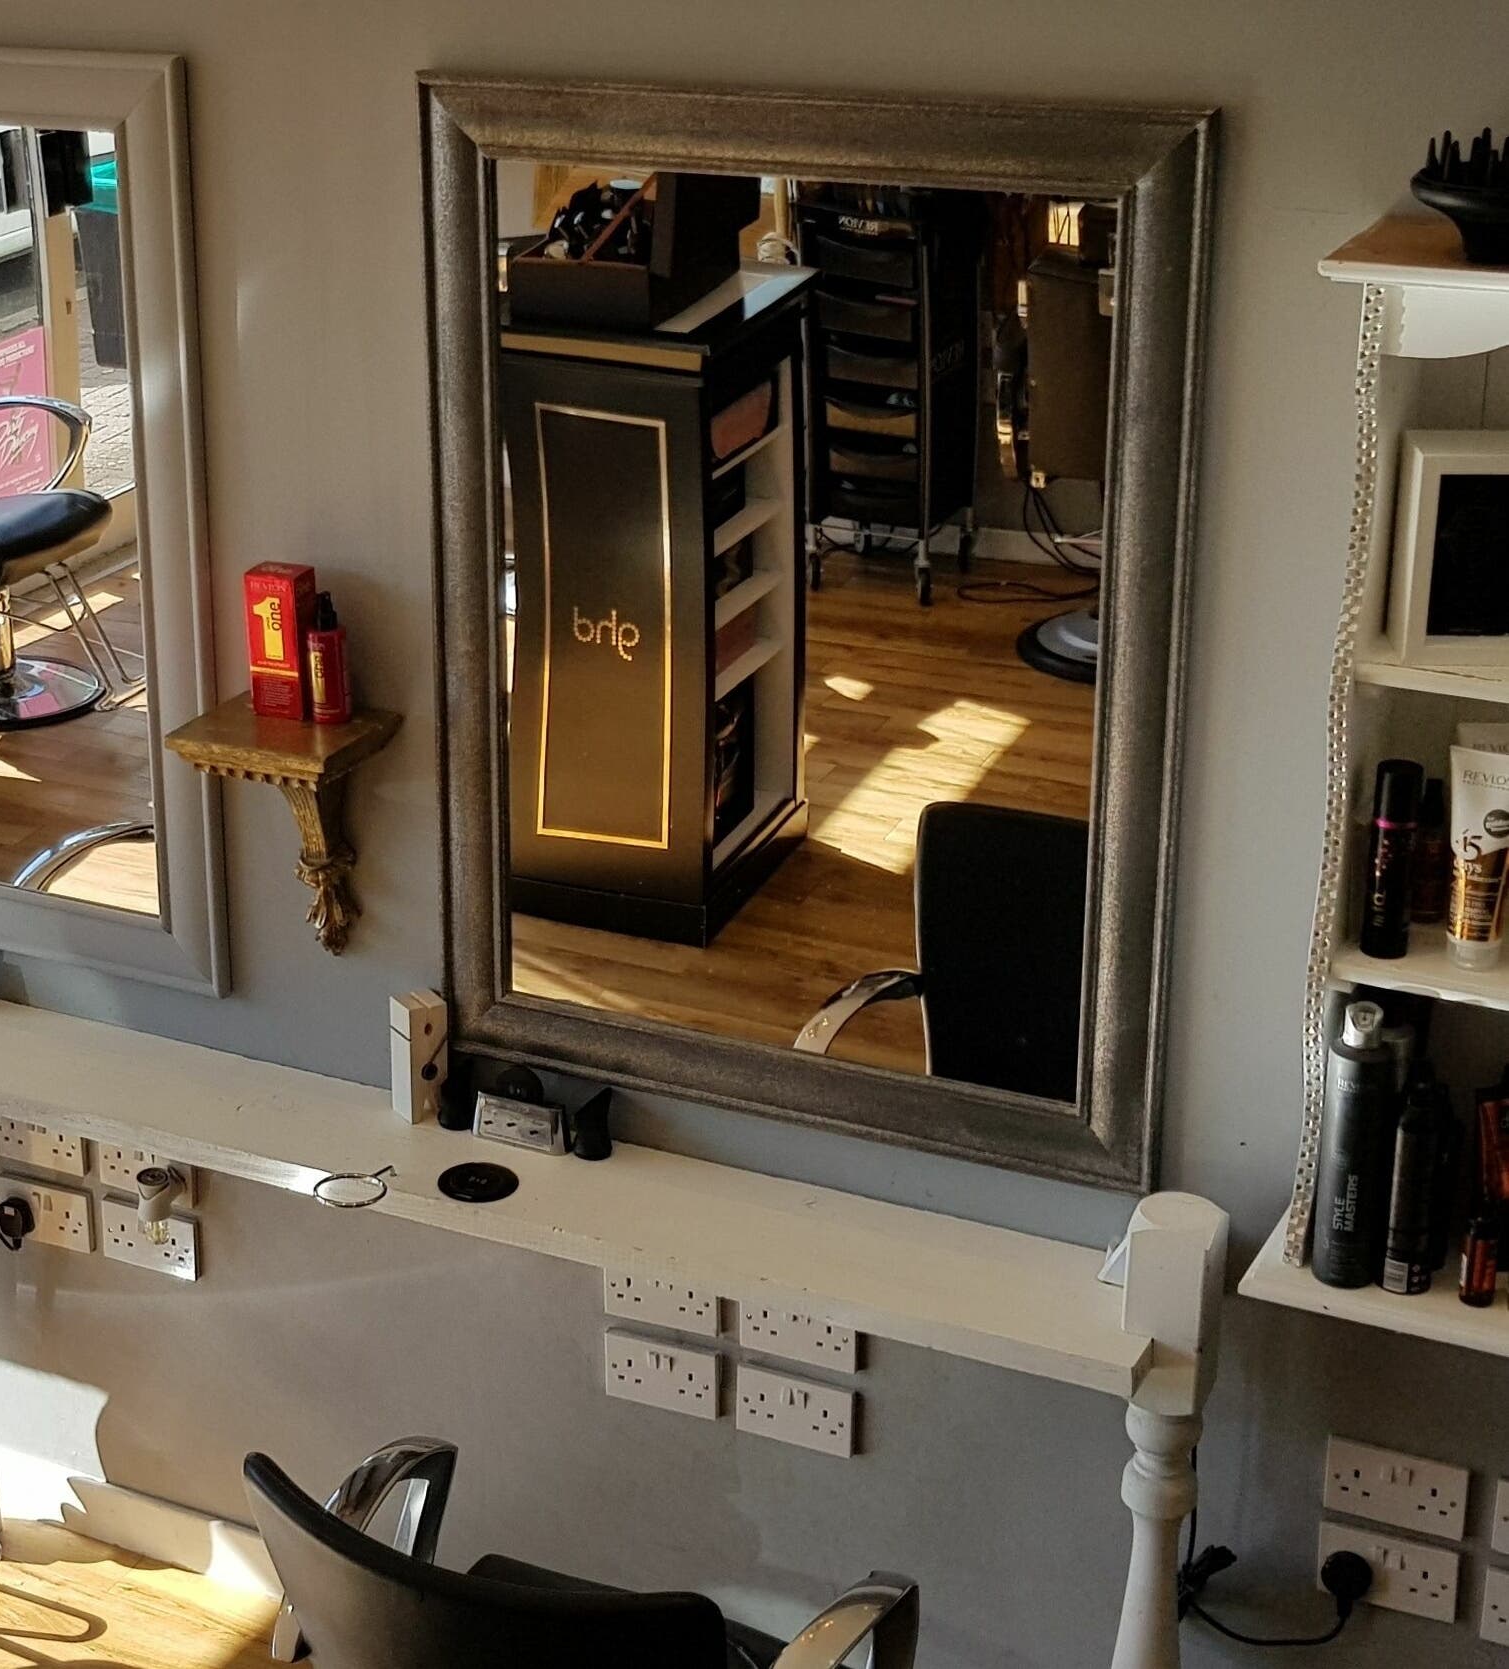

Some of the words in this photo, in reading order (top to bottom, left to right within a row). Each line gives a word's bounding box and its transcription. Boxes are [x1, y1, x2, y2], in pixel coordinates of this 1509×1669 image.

[269, 601, 281, 632] one
[1332, 1196, 1345, 1231] STYLE
[1343, 1174, 1358, 1232] MASTERS
